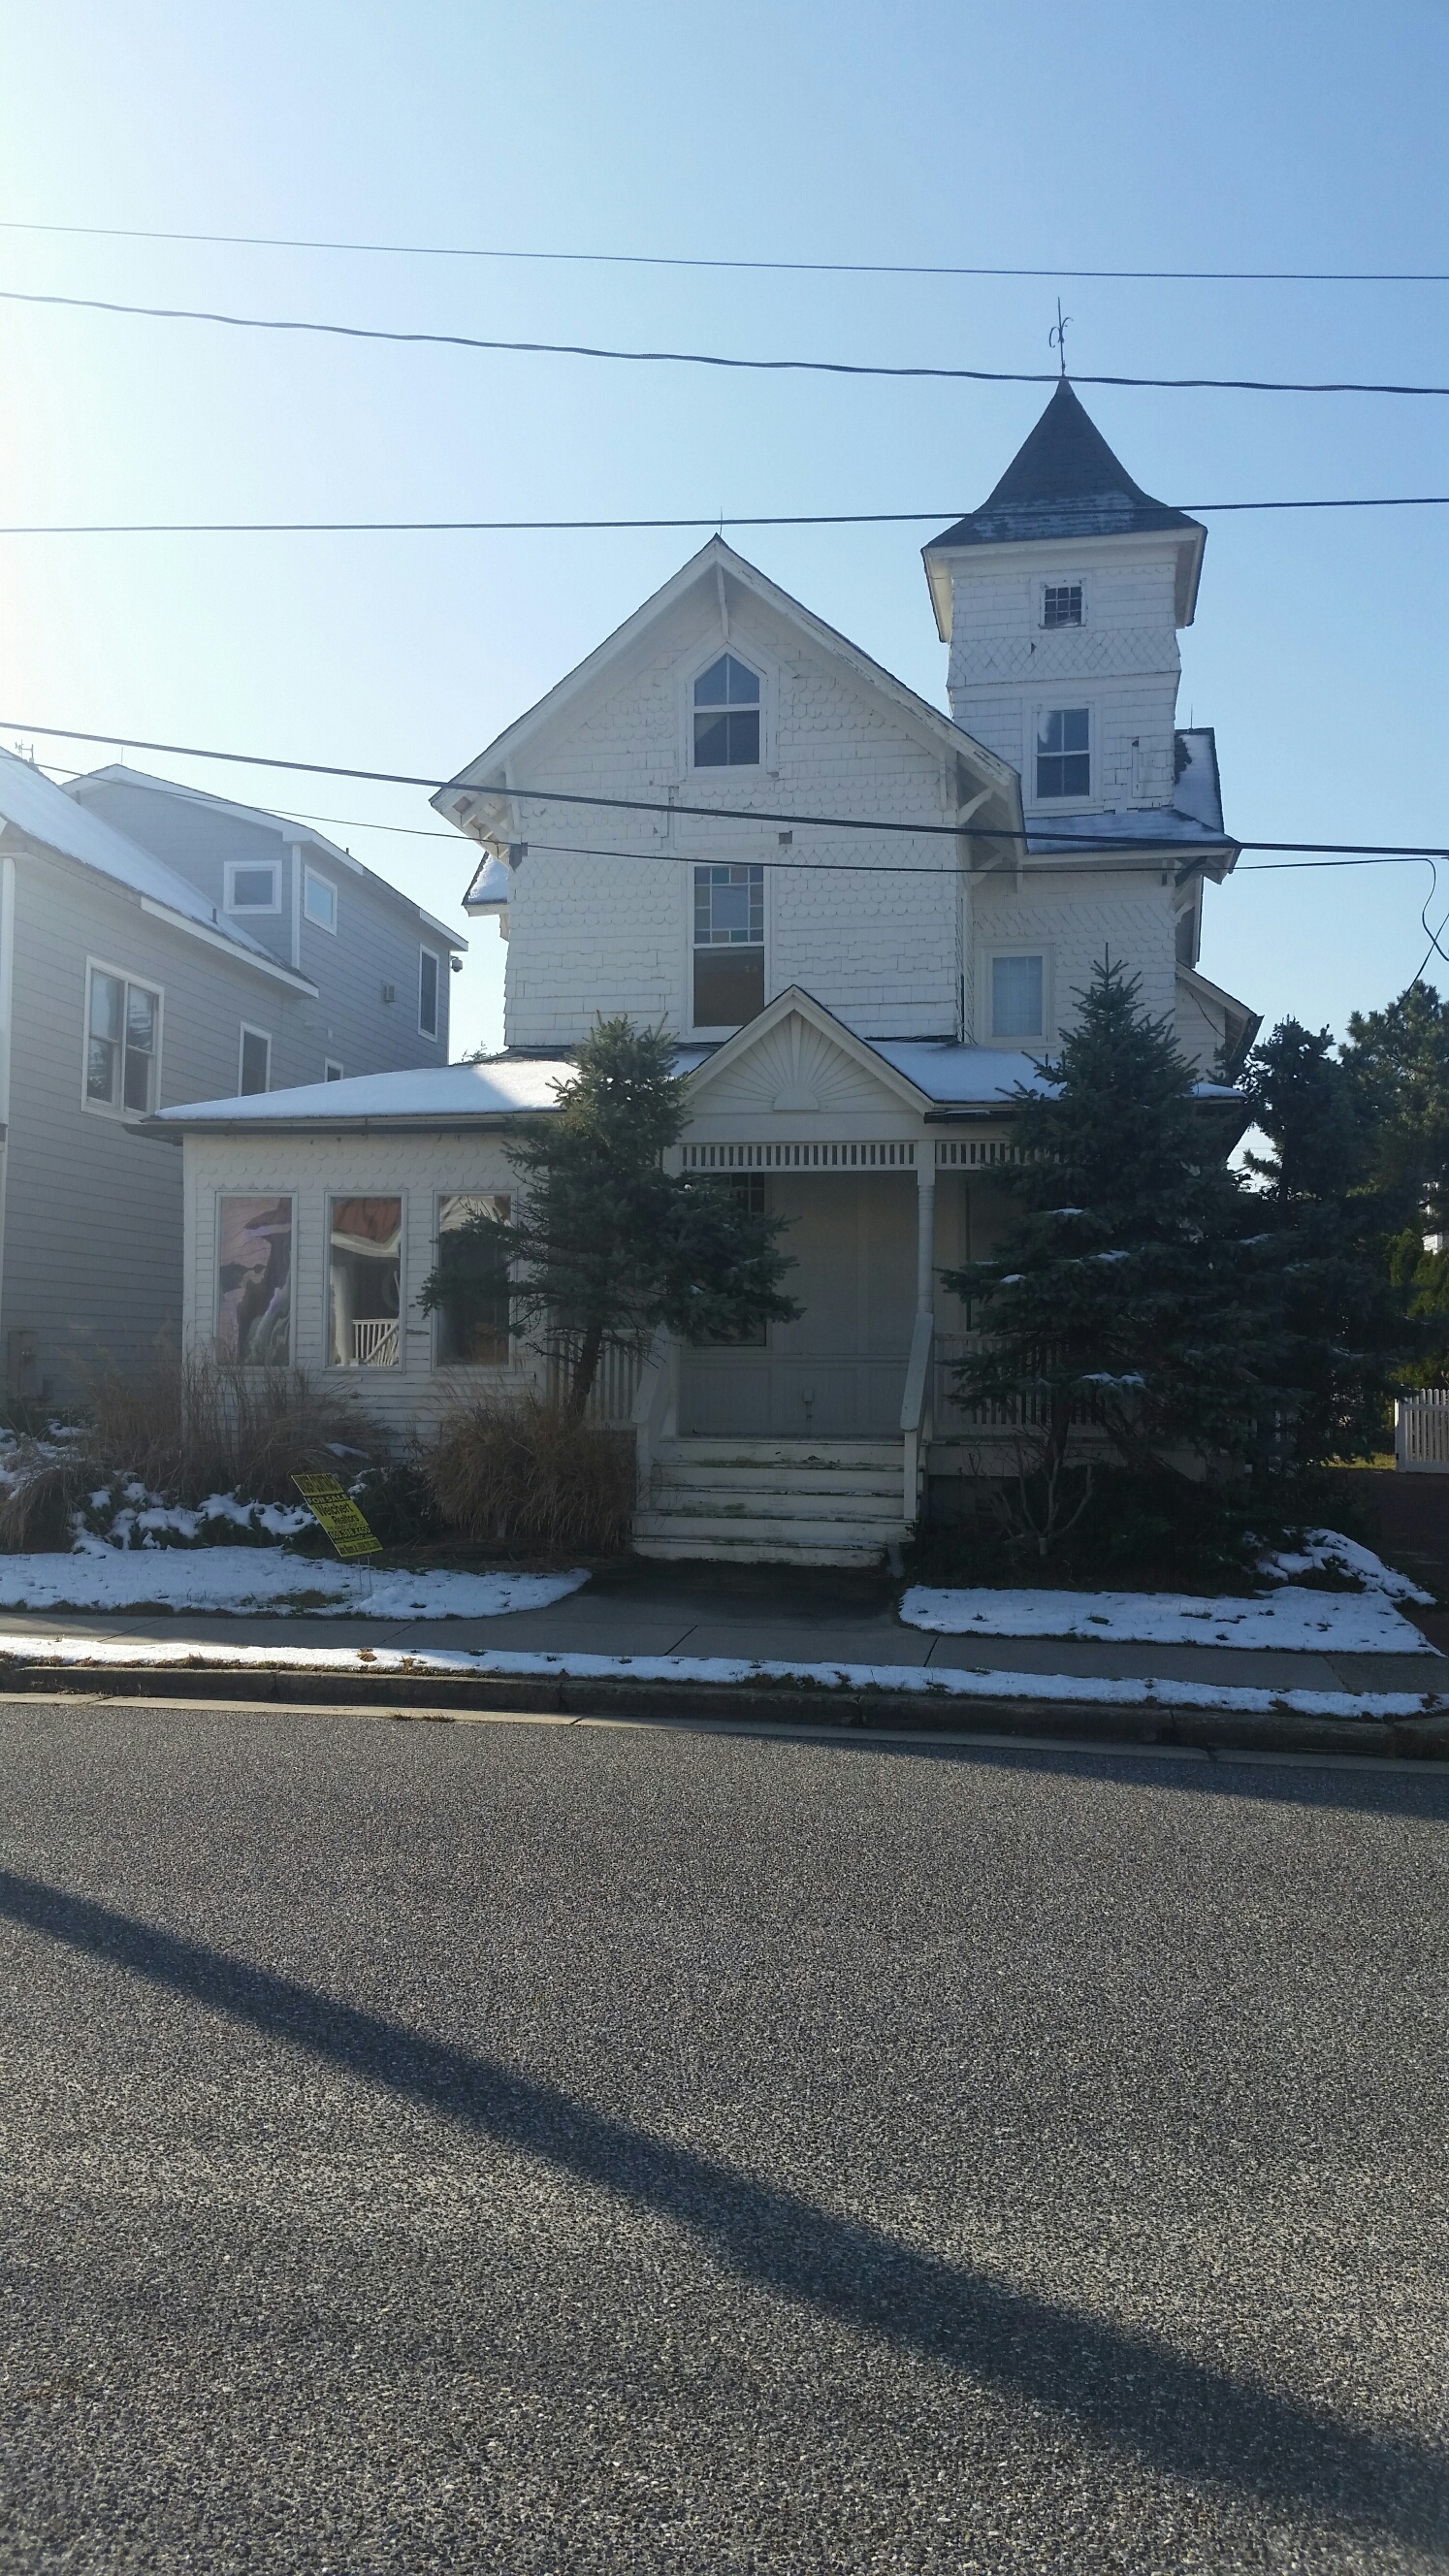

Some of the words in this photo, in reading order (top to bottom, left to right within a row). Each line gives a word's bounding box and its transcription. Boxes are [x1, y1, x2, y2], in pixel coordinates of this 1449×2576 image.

[327, 1494, 349, 1502] SALE
[314, 1501, 354, 1517] Weichert
[331, 1514, 360, 1526] Realtors
